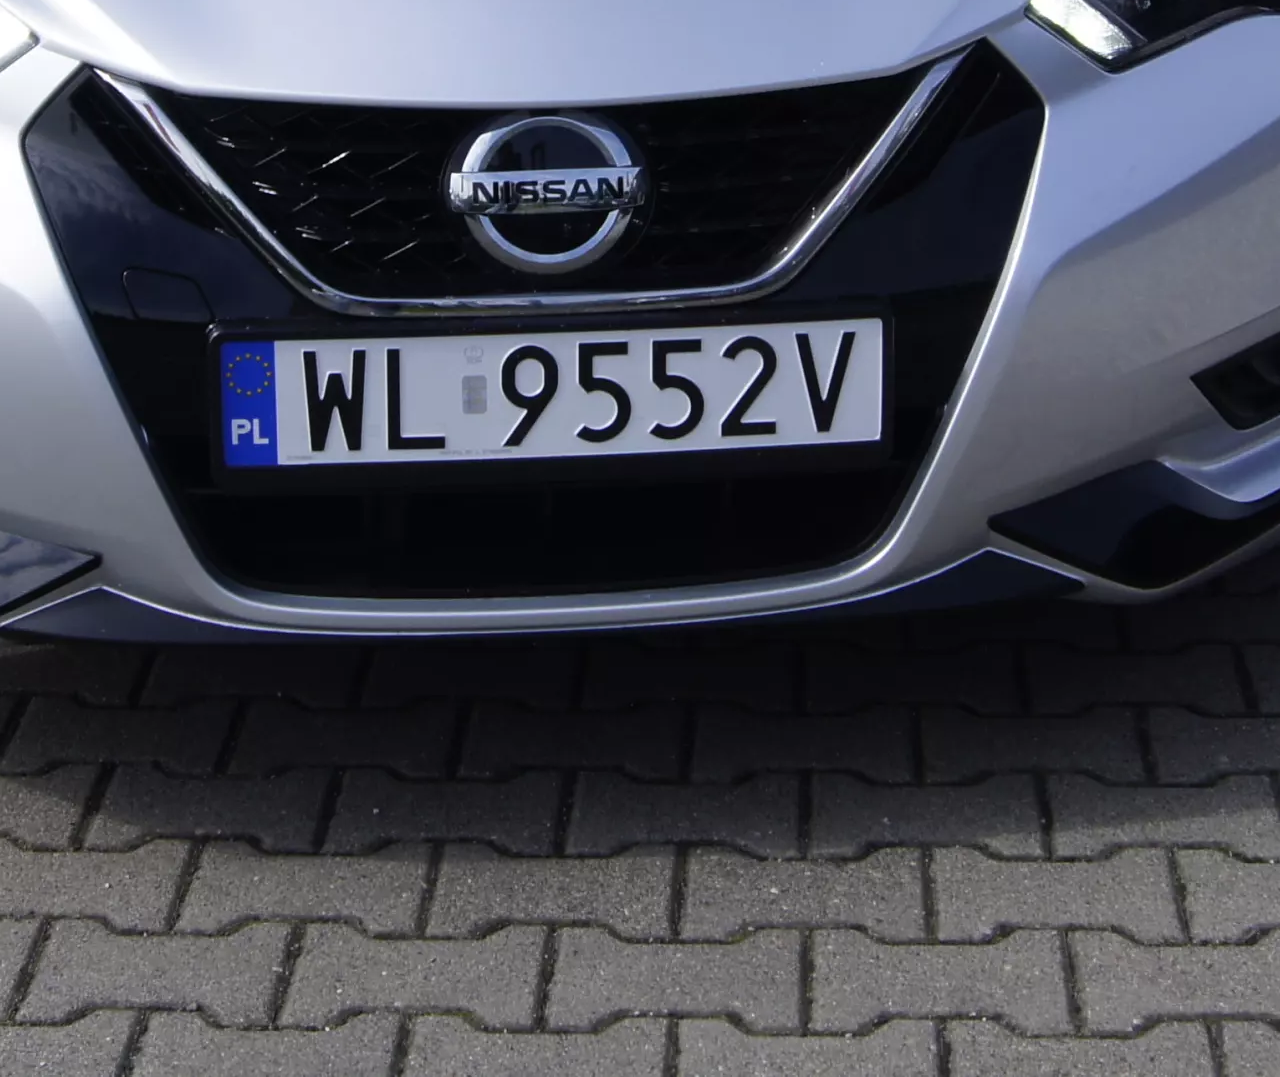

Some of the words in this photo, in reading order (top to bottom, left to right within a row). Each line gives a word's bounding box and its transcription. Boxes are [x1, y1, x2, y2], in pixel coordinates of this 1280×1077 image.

[471, 175, 625, 204] NISSAN
[302, 348, 446, 451] WL
[500, 331, 856, 446] 9552V
[231, 418, 269, 445] PL
